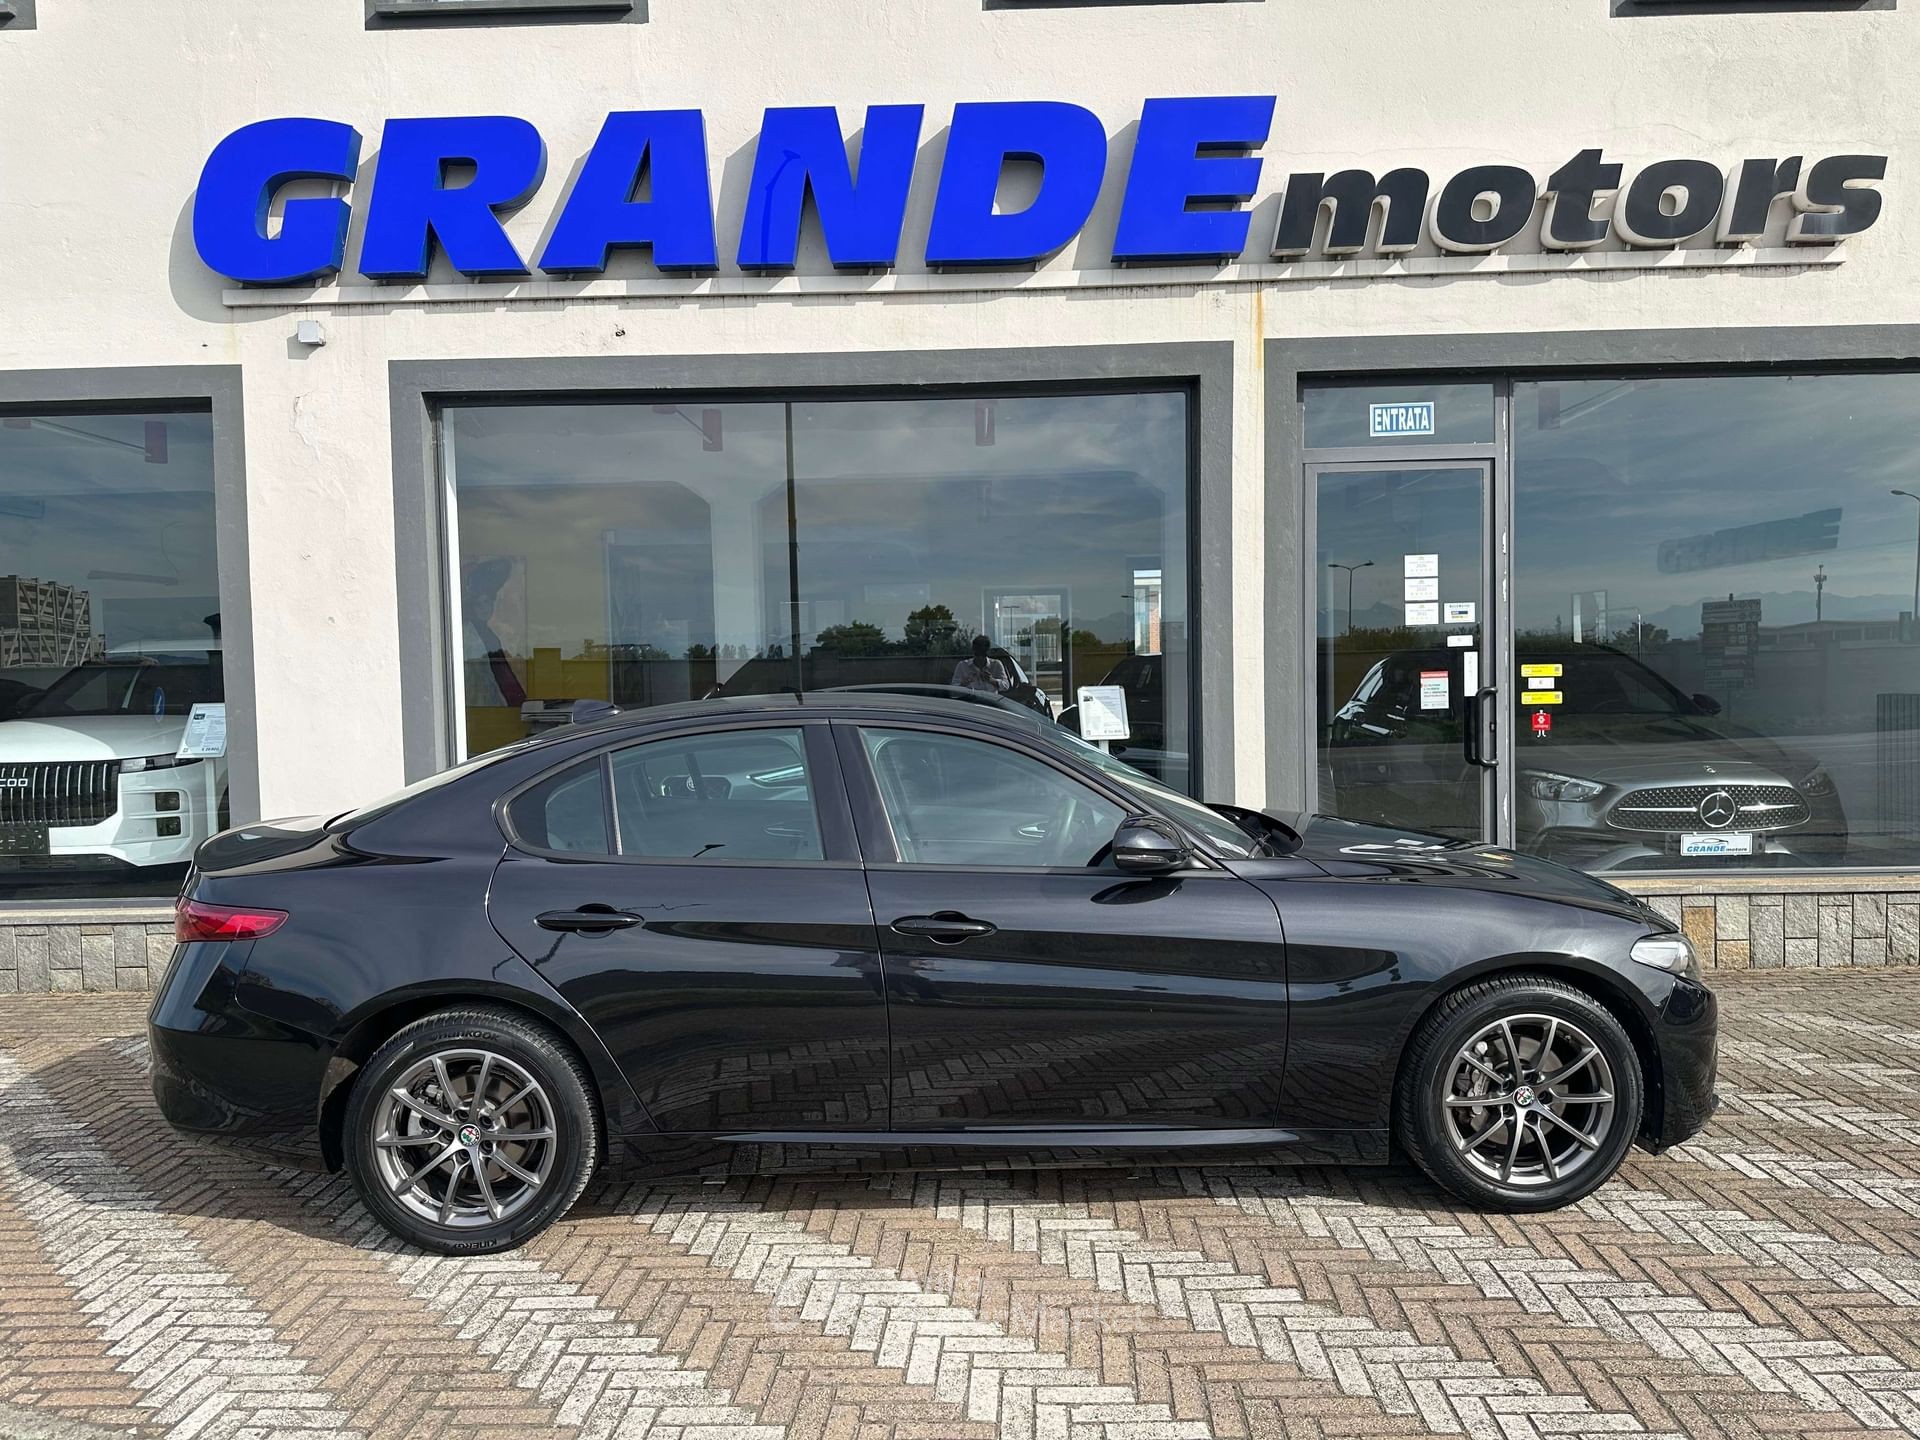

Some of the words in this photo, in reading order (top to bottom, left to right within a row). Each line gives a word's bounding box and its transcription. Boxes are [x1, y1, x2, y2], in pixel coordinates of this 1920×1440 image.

[192, 95, 1277, 285] GRANDE
[1271, 149, 1888, 256] motors
[1374, 407, 1430, 431] ENTRATA
[1686, 845, 1726, 853] GRANDE
